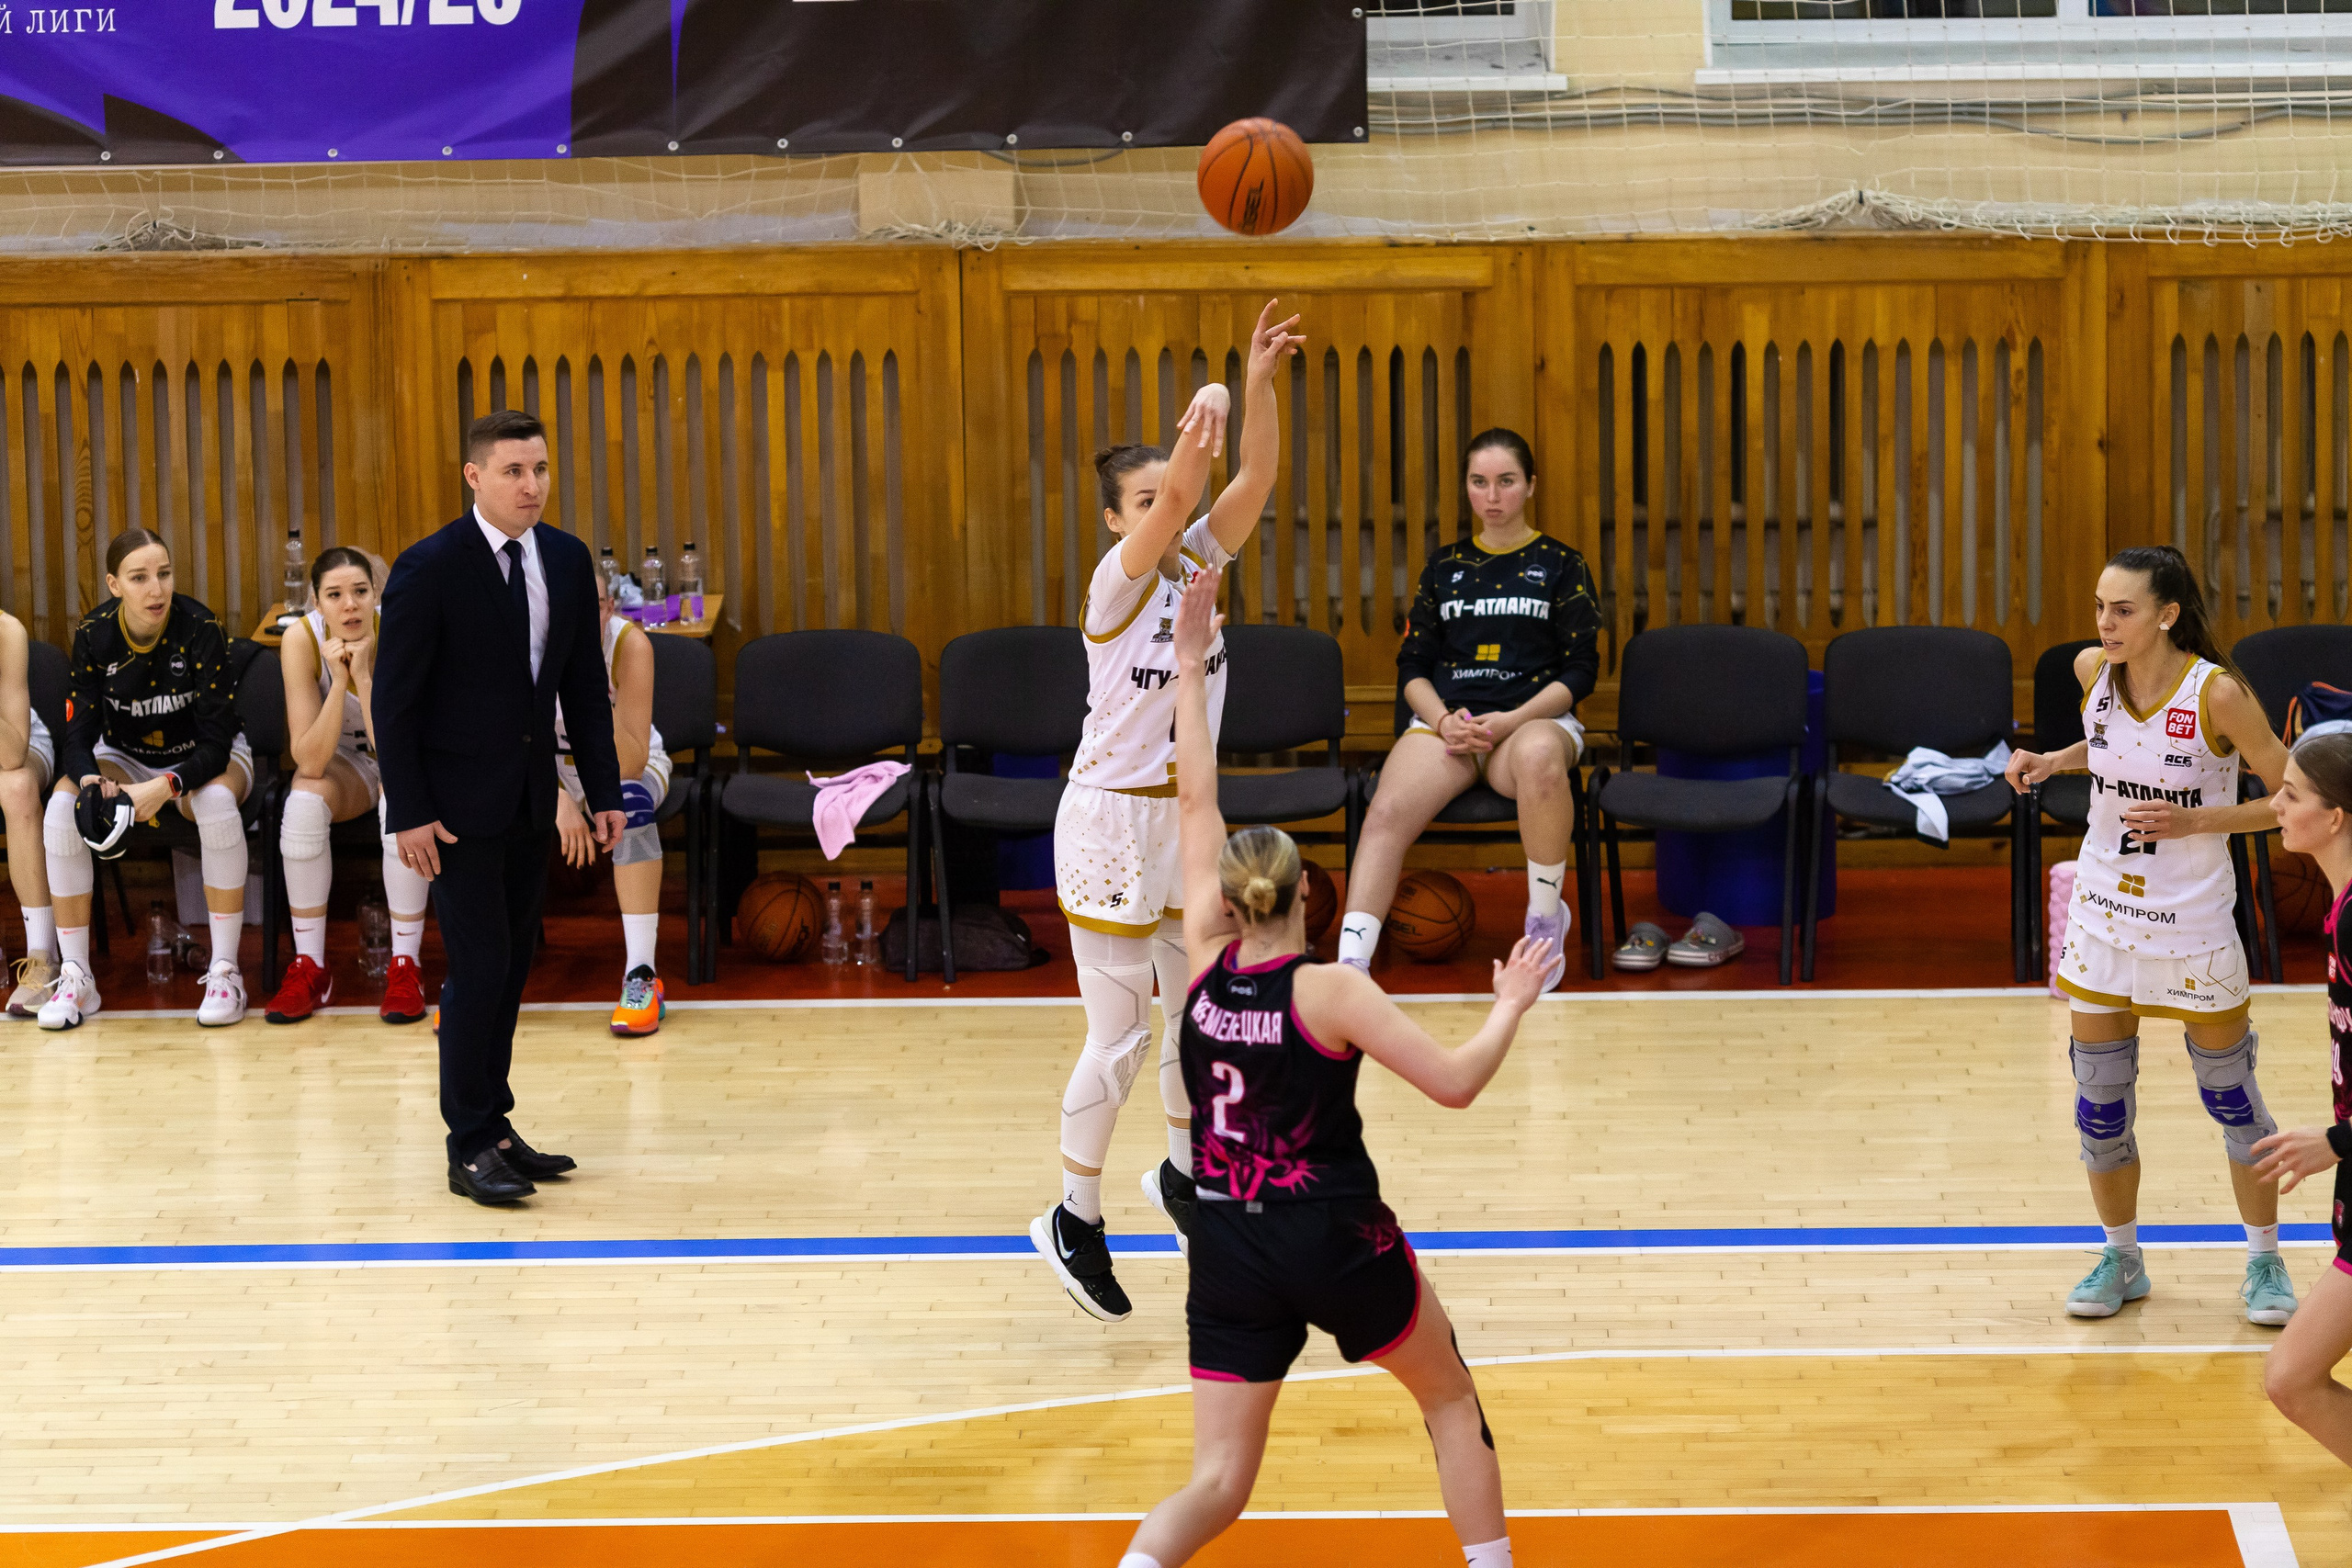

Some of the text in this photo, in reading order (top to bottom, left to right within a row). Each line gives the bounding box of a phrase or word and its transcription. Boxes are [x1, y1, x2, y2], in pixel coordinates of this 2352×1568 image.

[26, 8, 117, 34] ЛИГИ
[104, 691, 194, 717] У-АТЛАНТ
[2167, 722, 2193, 735] BET
[2169, 711, 2194, 725] FON
[2089, 771, 2203, 808] У-АТЛАНТА
[2087, 890, 2177, 925] ХИМПРОМ
[2166, 987, 2215, 1002] ХИМПРОМ
[1212, 1061, 1246, 1144] 2
